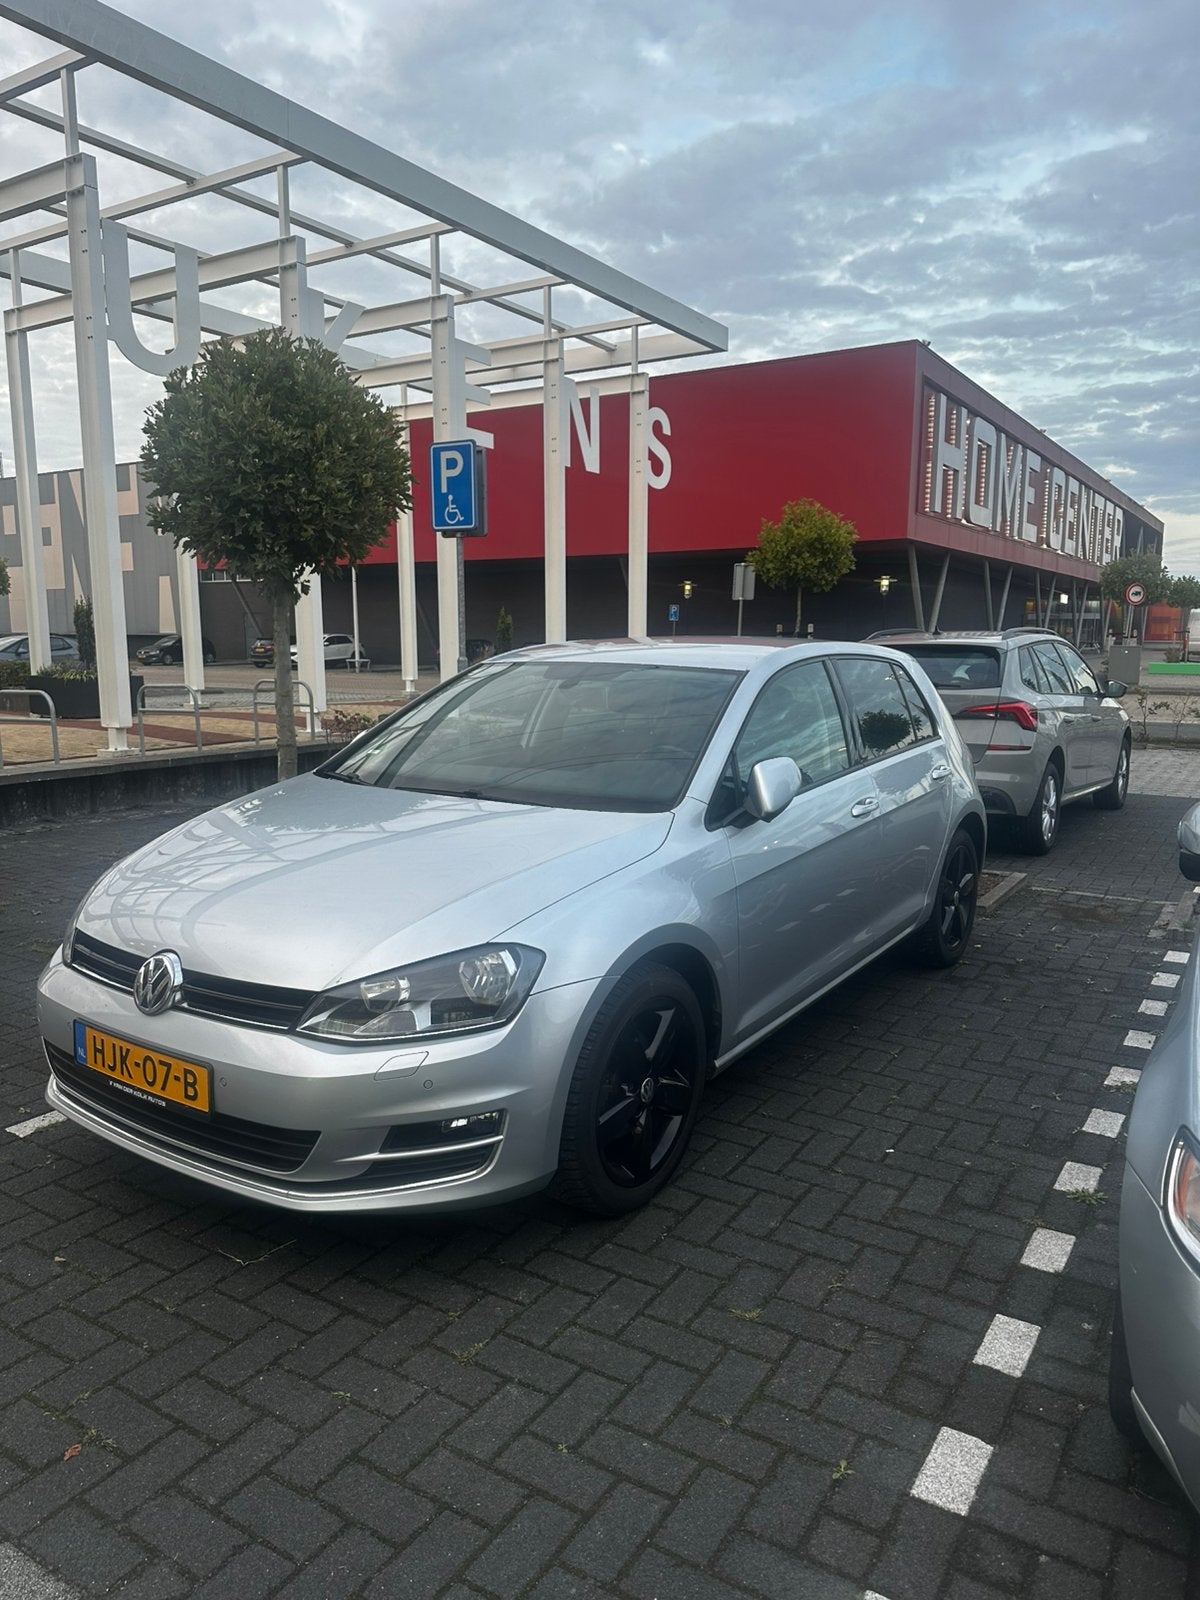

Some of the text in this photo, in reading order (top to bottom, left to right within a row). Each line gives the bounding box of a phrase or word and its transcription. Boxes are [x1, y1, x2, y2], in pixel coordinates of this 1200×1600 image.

[440, 451, 464, 493] P
[929, 392, 1124, 565] HOME CENTER
[93, 1035, 198, 1102] HJK-07-B
